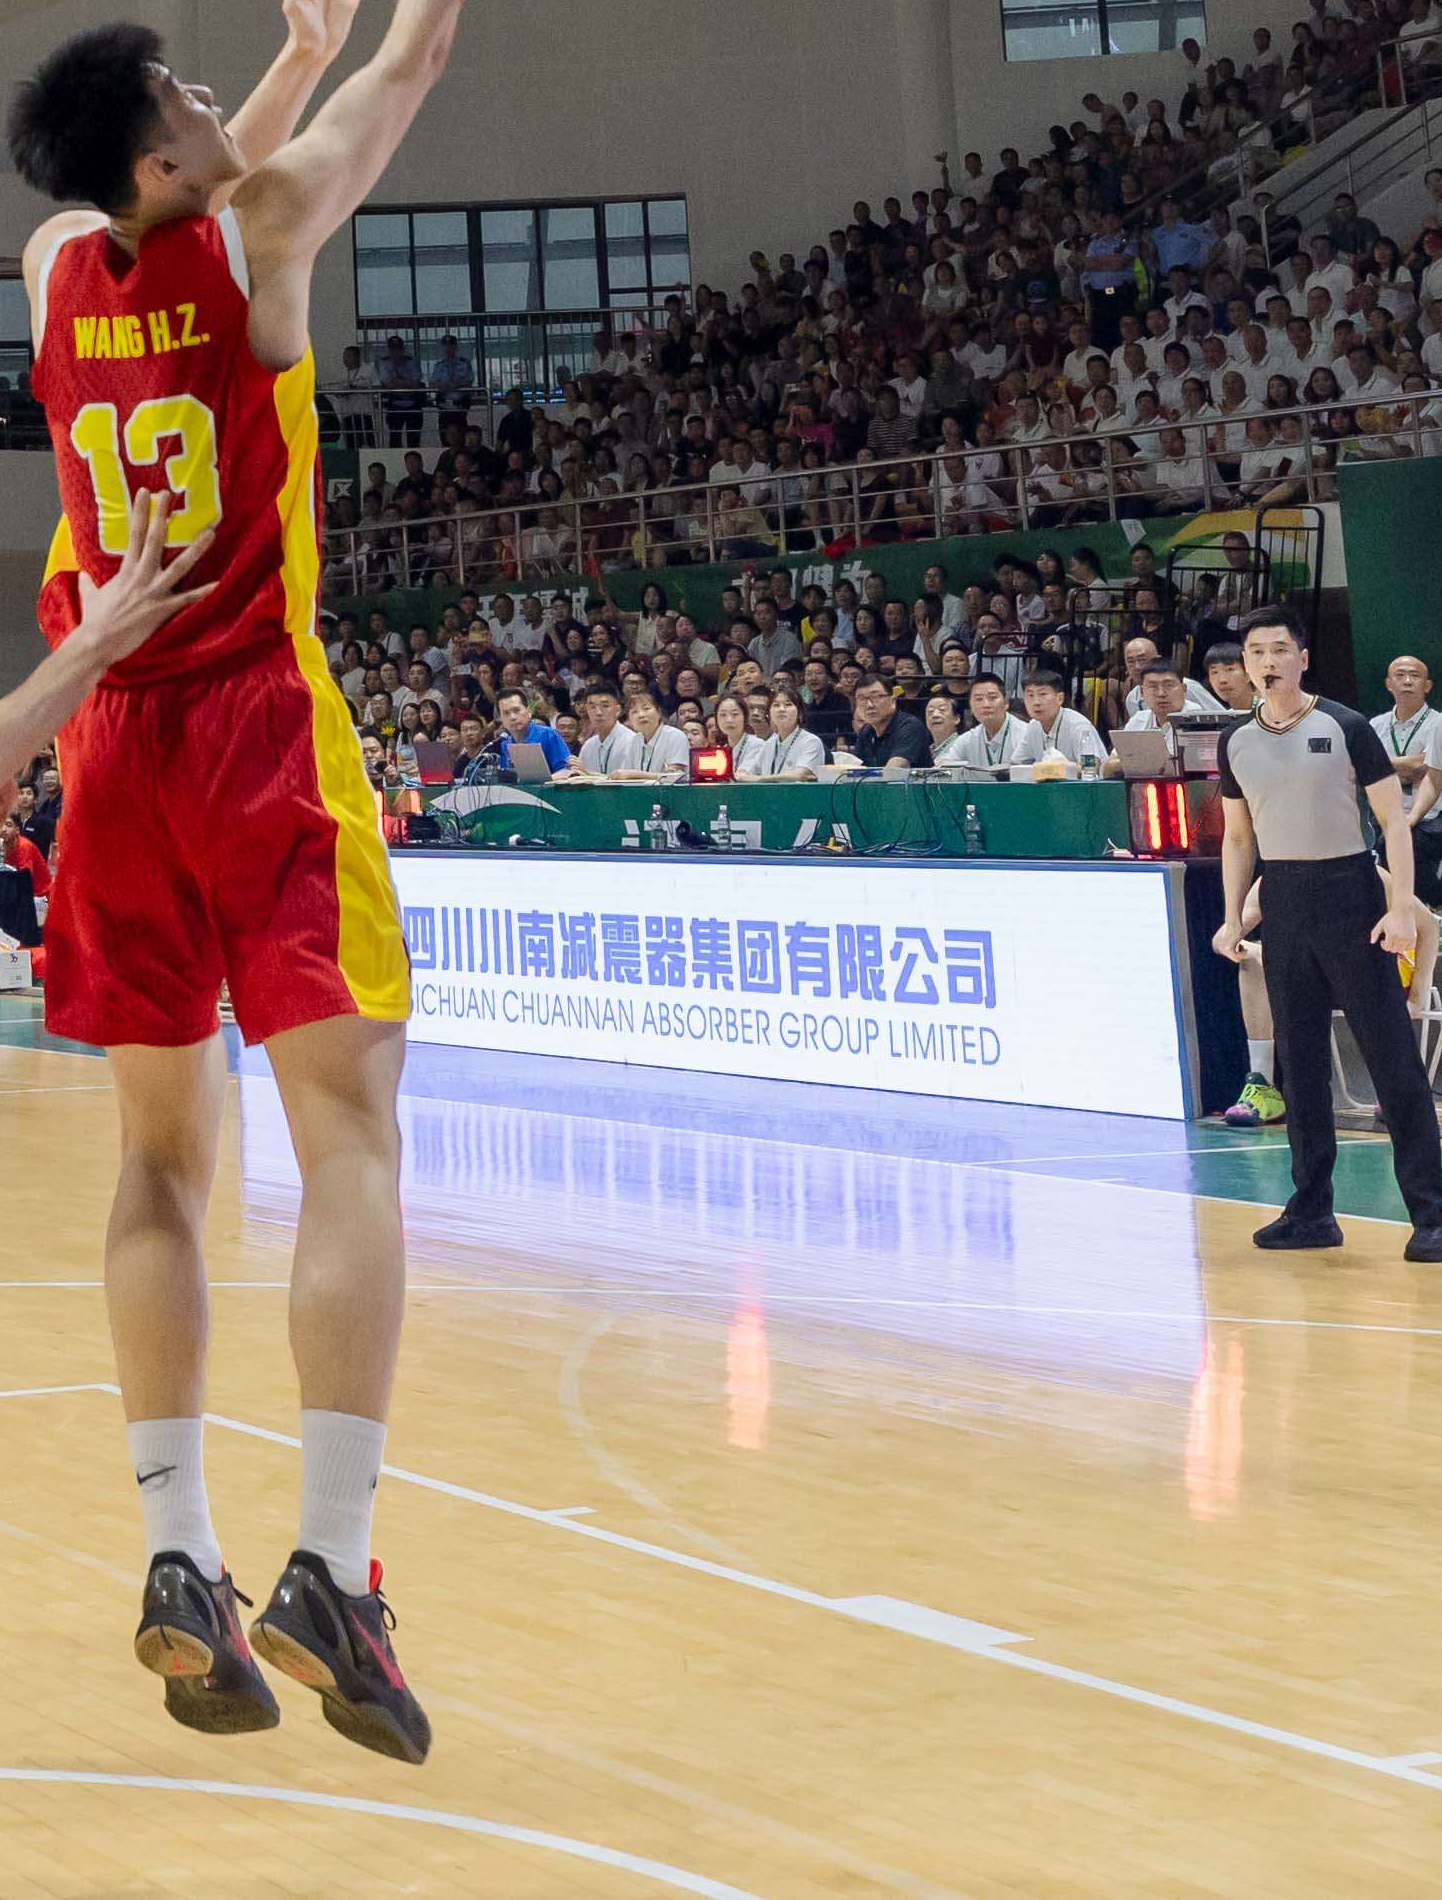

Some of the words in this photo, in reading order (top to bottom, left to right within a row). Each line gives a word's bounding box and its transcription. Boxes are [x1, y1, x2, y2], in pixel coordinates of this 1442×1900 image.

[73, 315, 144, 360] WANG
[148, 303, 210, 355] H.Z.
[71, 393, 223, 557] 13
[403, 905, 997, 1009] 四川川南减震器集团有限公司
[413, 983, 497, 1021] ICHUAN
[502, 989, 635, 1034] CHUANNAN
[642, 1000, 771, 1046] ABSORBER
[779, 1011, 879, 1056] GROUP
[888, 1019, 1002, 1066] LIMITED
